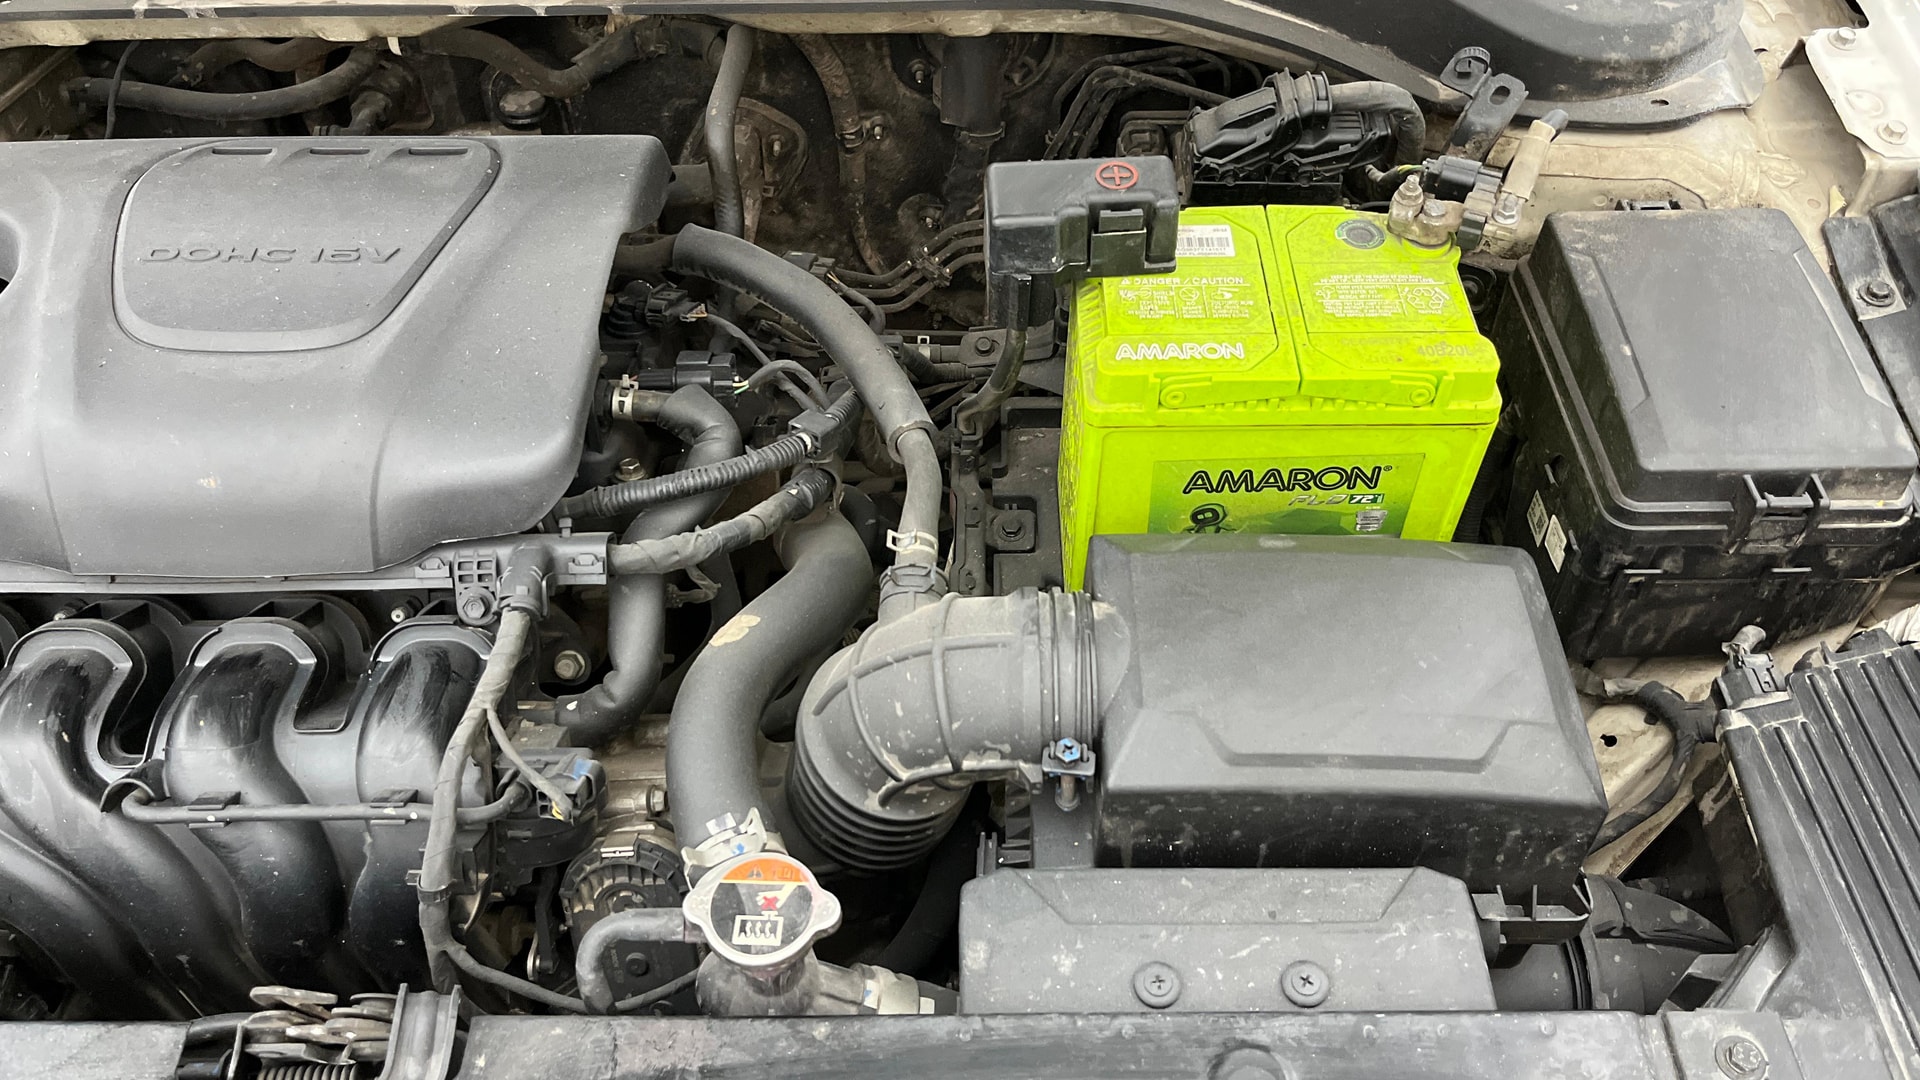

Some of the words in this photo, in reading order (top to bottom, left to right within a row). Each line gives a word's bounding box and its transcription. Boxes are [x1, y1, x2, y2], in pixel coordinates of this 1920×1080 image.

[141, 247, 297, 263] DOHC
[309, 247, 401, 263] 16V
[1133, 277, 1181, 285] DANGER
[1192, 276, 1244, 285] CAUTION
[1115, 342, 1245, 361] AMARON
[1183, 465, 1382, 494] AMARON
[1288, 493, 1349, 506] FLO
